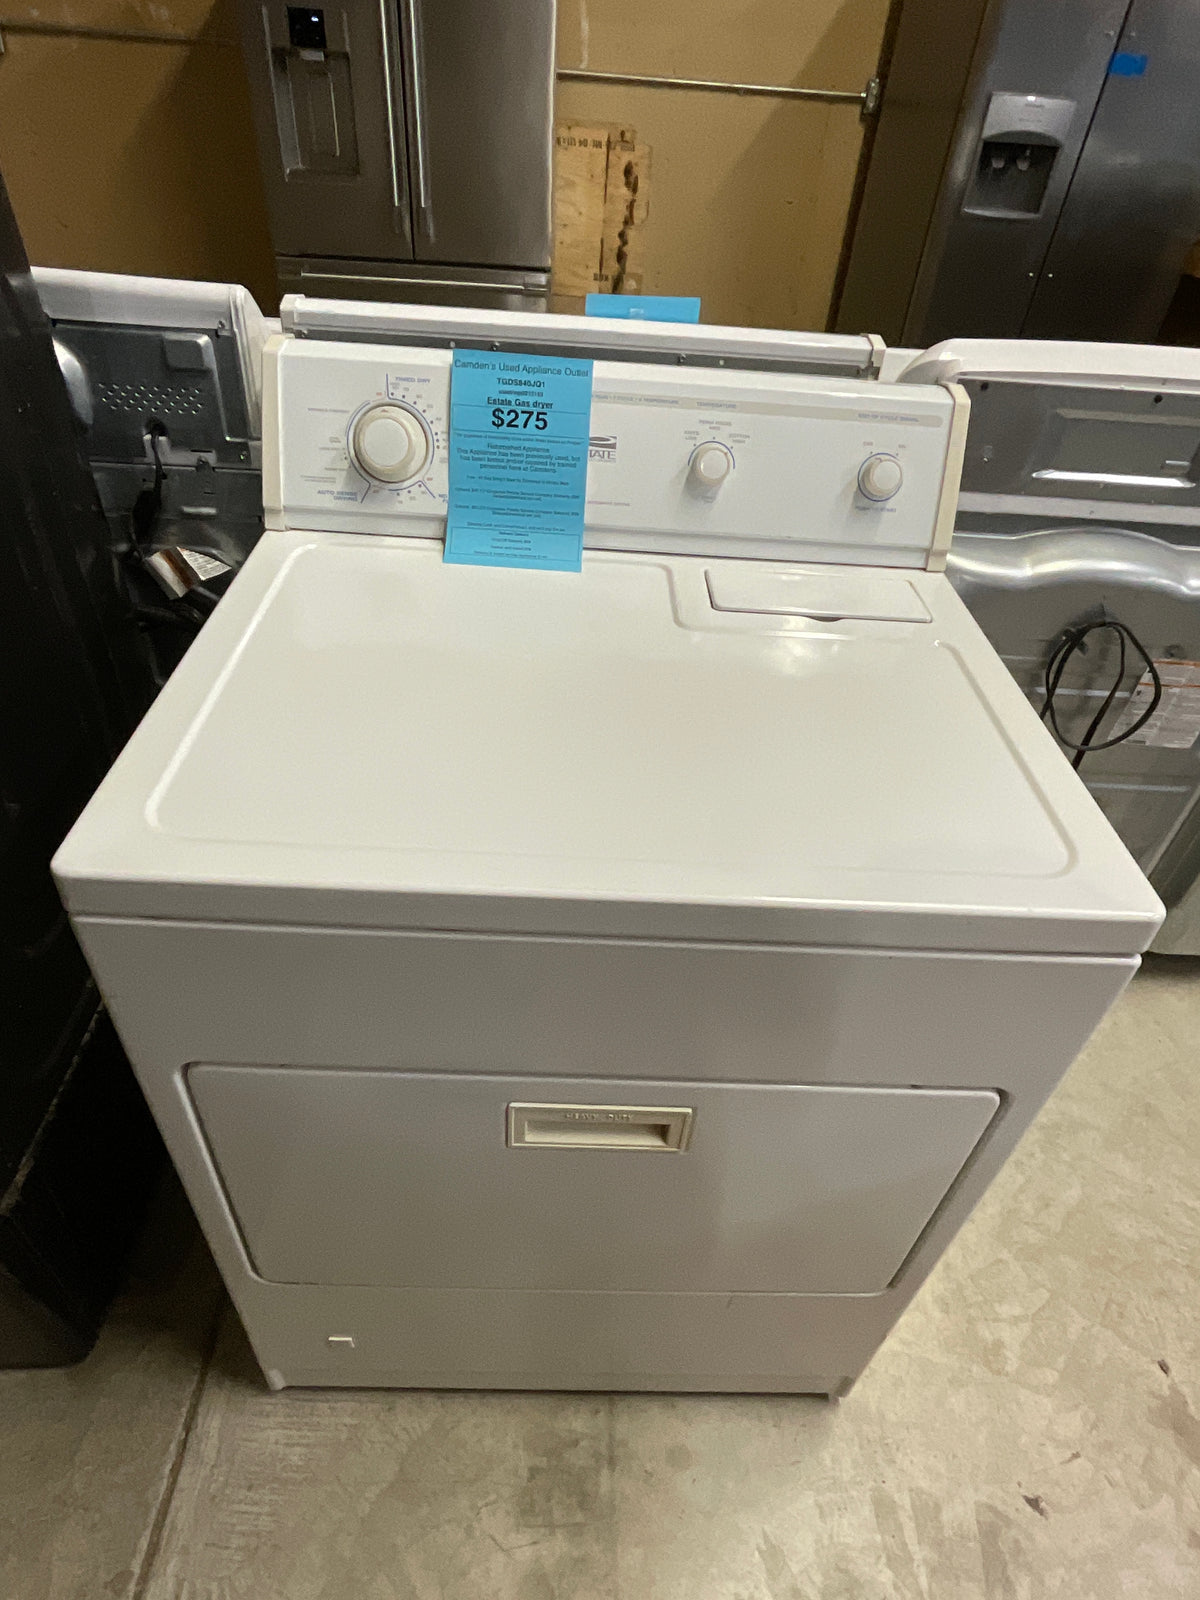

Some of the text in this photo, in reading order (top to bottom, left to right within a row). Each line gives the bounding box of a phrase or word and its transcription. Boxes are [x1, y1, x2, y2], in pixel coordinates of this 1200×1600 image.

[454, 359, 589, 377] Camden's Used Appliance Outlet
[487, 396, 553, 410] Estate Gas dryer
[491, 407, 548, 430] $275
